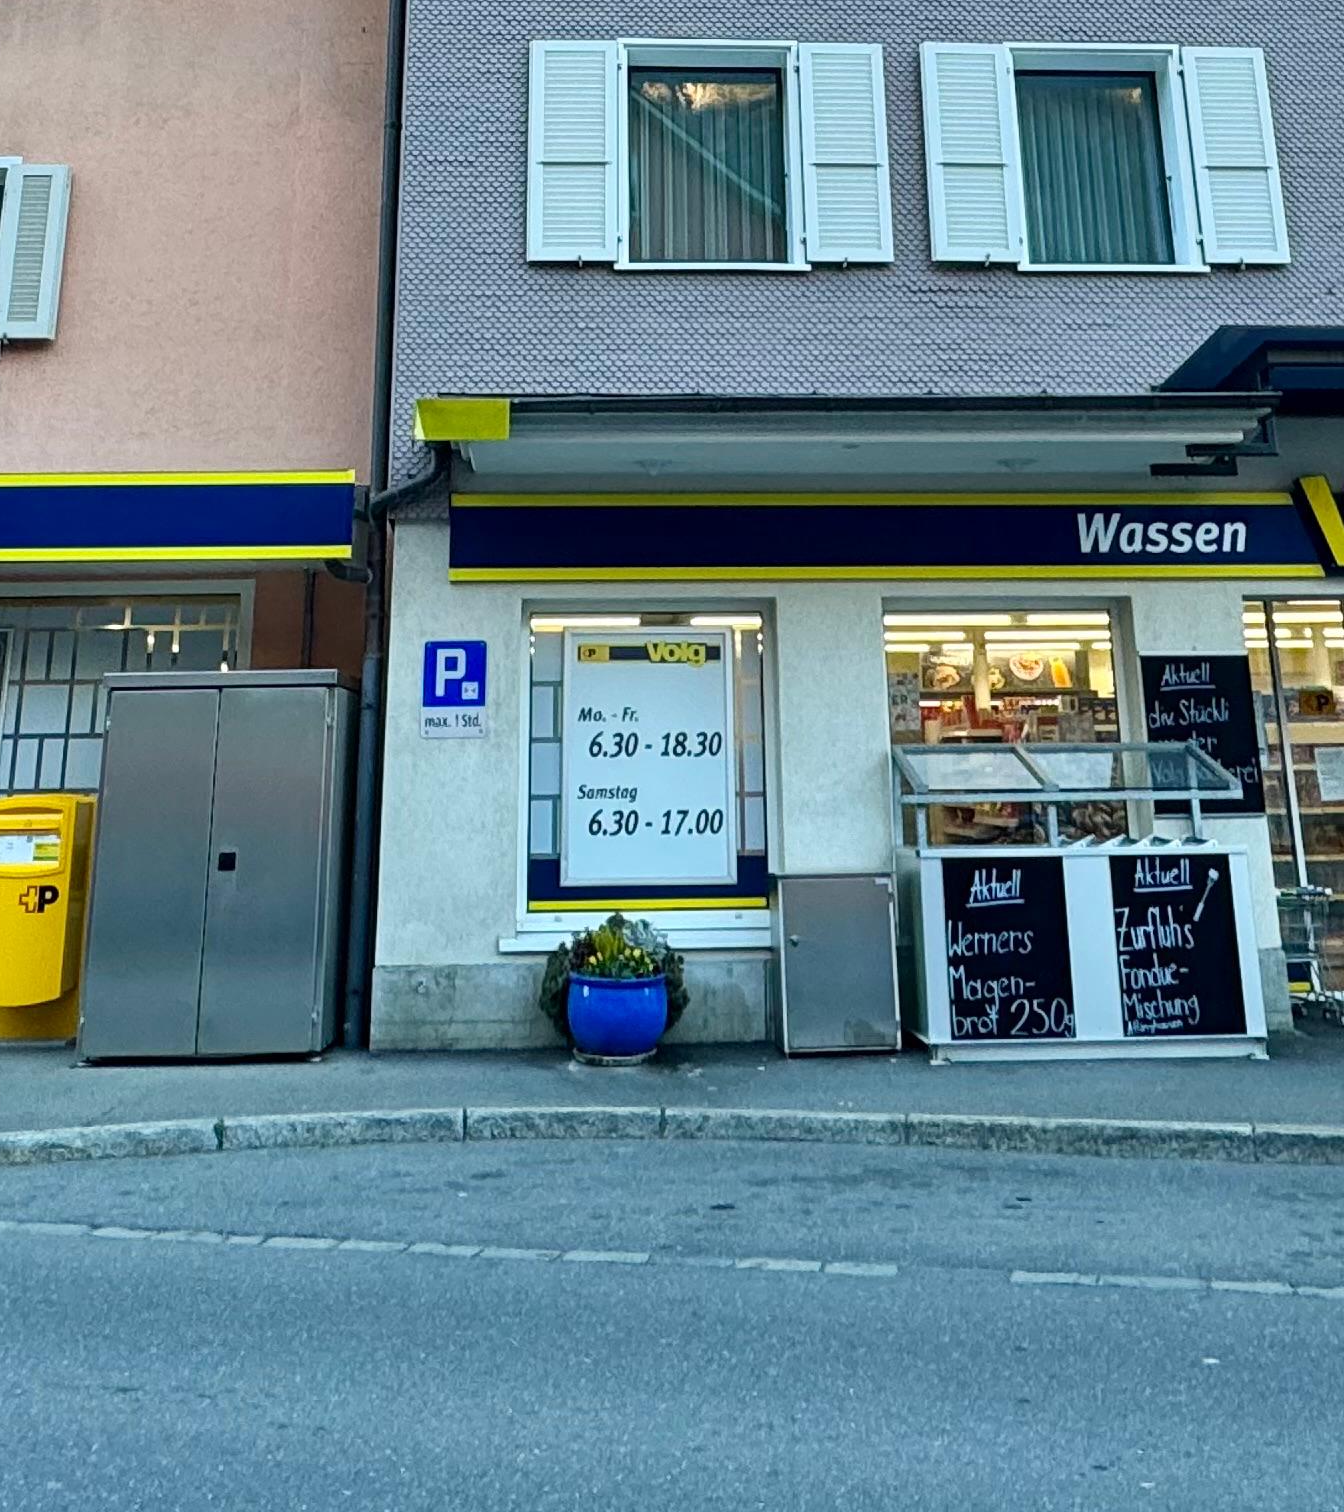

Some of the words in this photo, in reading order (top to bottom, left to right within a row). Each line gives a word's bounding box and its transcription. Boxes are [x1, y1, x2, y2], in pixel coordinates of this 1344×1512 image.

[1076, 512, 1247, 554] Wassen
[646, 640, 706, 668] Volg
[435, 648, 467, 697] P
[1160, 661, 1211, 686] Aktuell
[425, 716, 452, 728] max.
[462, 712, 482, 728] Std.
[577, 707, 606, 722] Mo.
[621, 707, 640, 722] Fr.
[588, 731, 639, 758] 6.30
[660, 731, 722, 758] 18.30
[576, 784, 638, 803] Samstag
[588, 808, 639, 836] 6.30
[660, 808, 724, 836] 17.00
[969, 868, 1022, 903] Aktuell
[1134, 856, 1190, 888] Aktuell
[37, 884, 60, 913] P
[947, 920, 1034, 958] Werners
[949, 965, 1036, 1010] Magen-
[1118, 953, 1190, 990] Fondue-
[1010, 997, 1075, 1038] 250g
[1122, 988, 1201, 1026] Mischung
